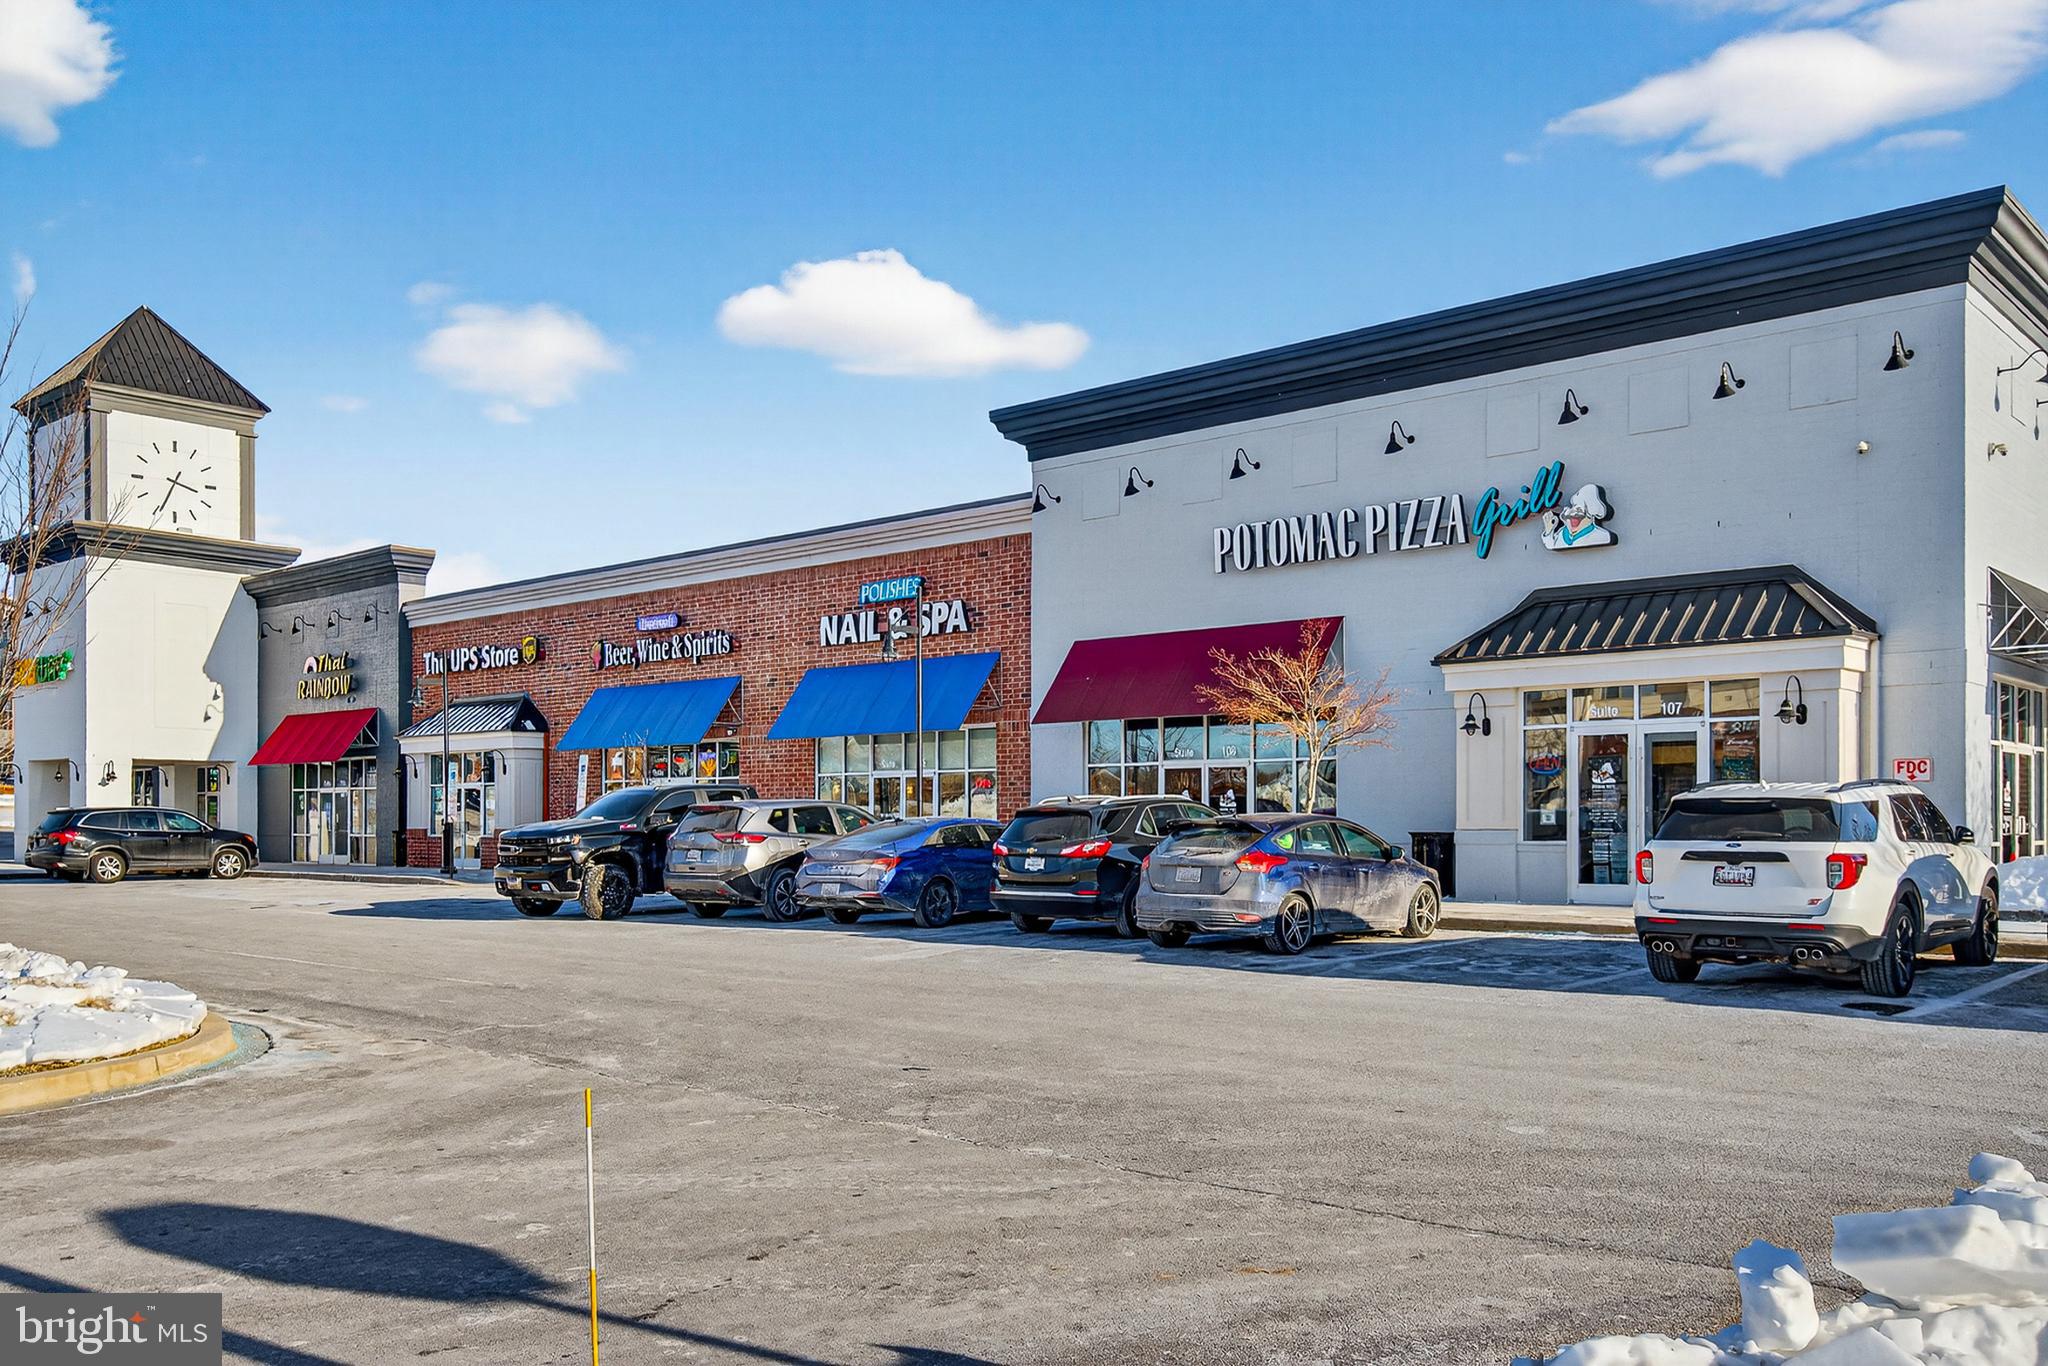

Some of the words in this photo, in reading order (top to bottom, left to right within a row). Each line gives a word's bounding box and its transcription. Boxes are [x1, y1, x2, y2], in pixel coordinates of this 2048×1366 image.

[1213, 508, 1359, 574] POTOMAC
[1364, 493, 1470, 554] PIZZA
[862, 578, 921, 604] POLISHES
[820, 610, 881, 647] NAIL
[888, 606, 908, 640] &
[920, 600, 968, 637] SPA
[317, 651, 348, 673] That
[450, 645, 479, 672] UPS
[481, 644, 519, 669] Store
[603, 640, 637, 668] Beer,
[636, 636, 671, 664] Wine
[671, 634, 683, 660] &
[684, 630, 731, 665] Spirits
[297, 674, 352, 700] RAINBOW
[1590, 703, 1619, 718] Suite
[1661, 701, 1683, 716] 107
[1896, 759, 1928, 775] FDC
